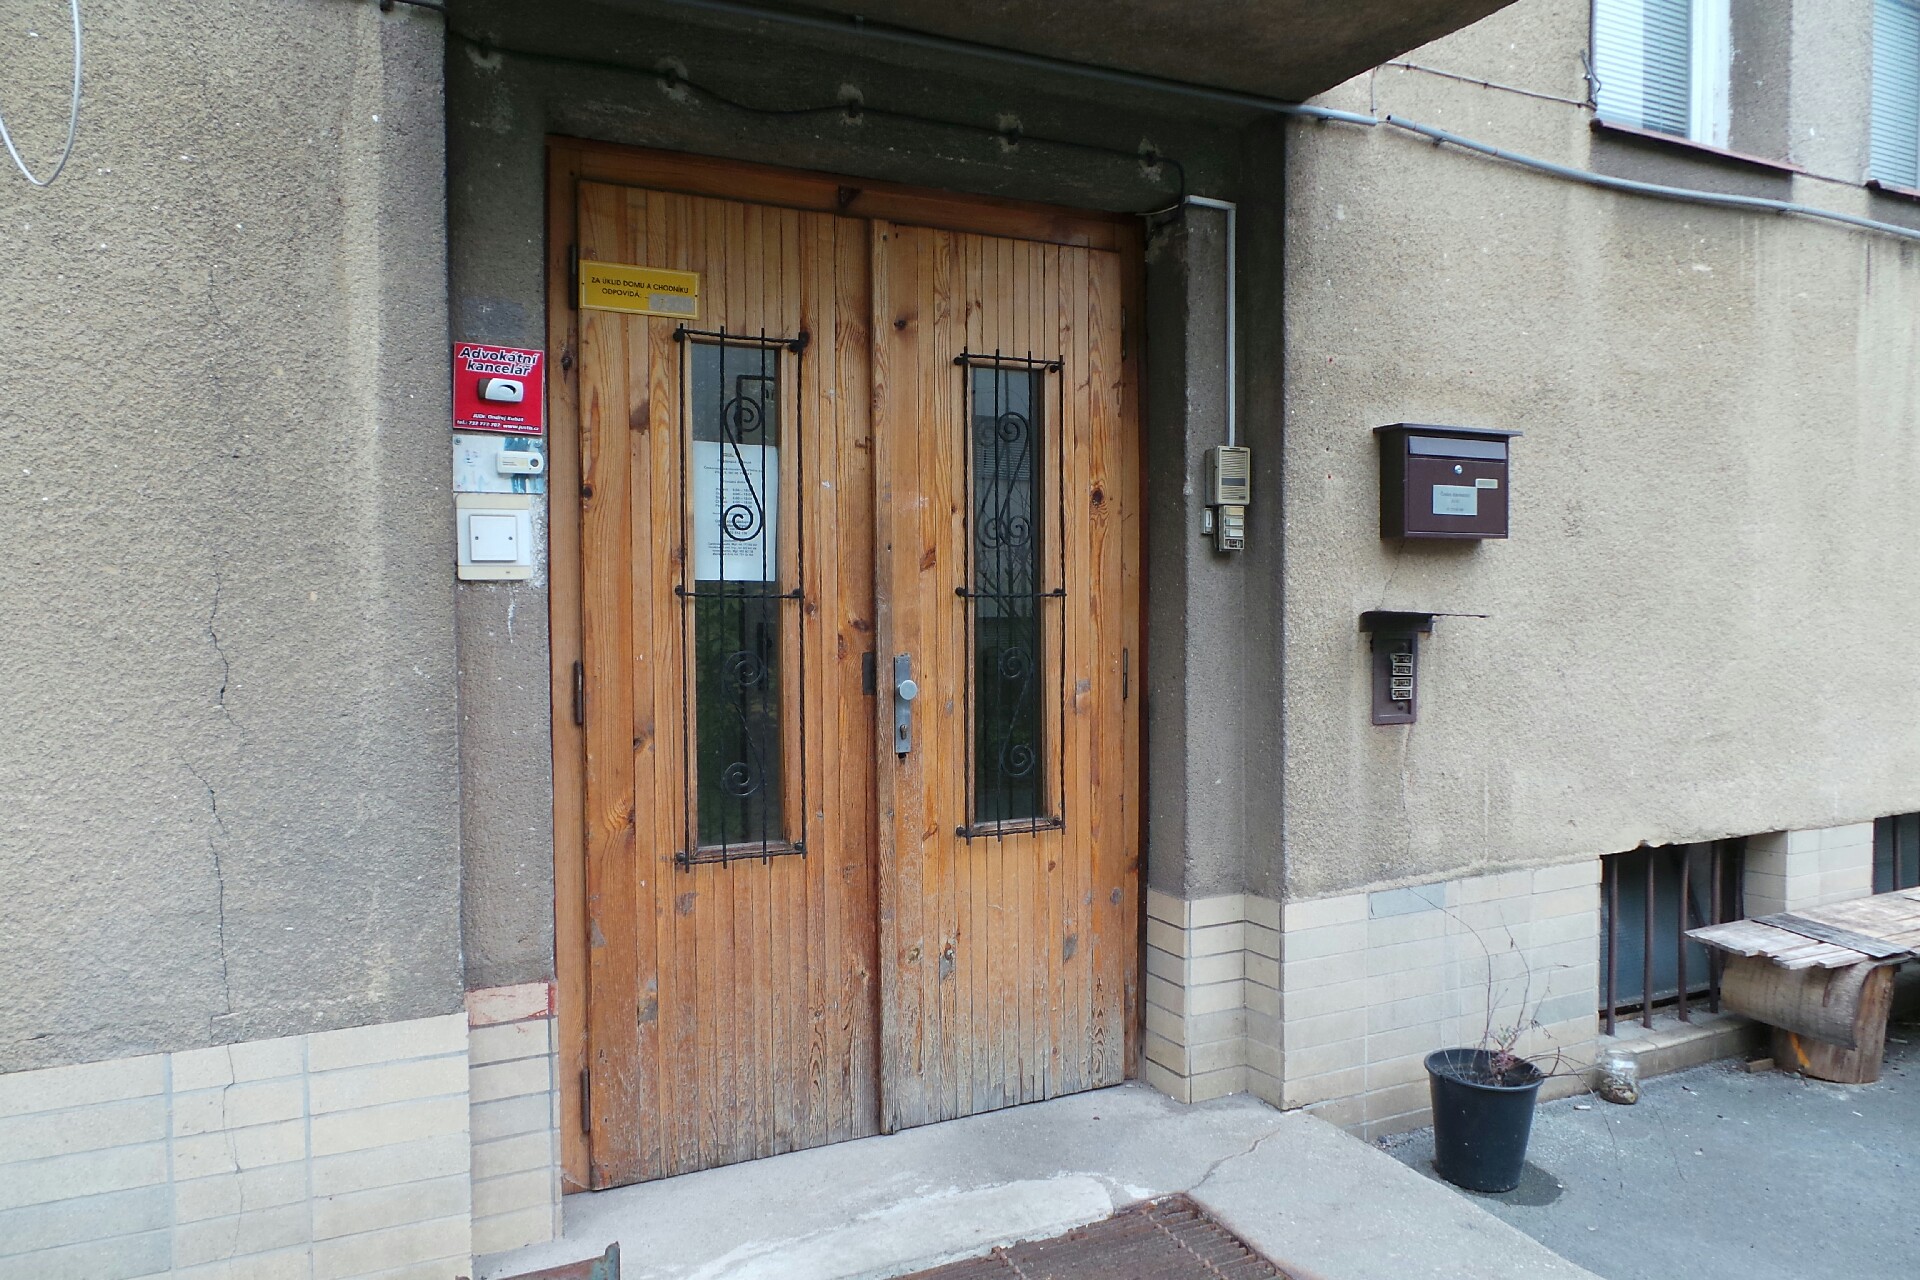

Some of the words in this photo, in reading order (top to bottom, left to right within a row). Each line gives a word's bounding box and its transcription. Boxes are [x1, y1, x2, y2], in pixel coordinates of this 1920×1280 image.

[591, 276, 601, 284] ZA
[623, 280, 645, 289] DOMU
[459, 346, 540, 365] Advokátní
[466, 359, 533, 376] kancelář
